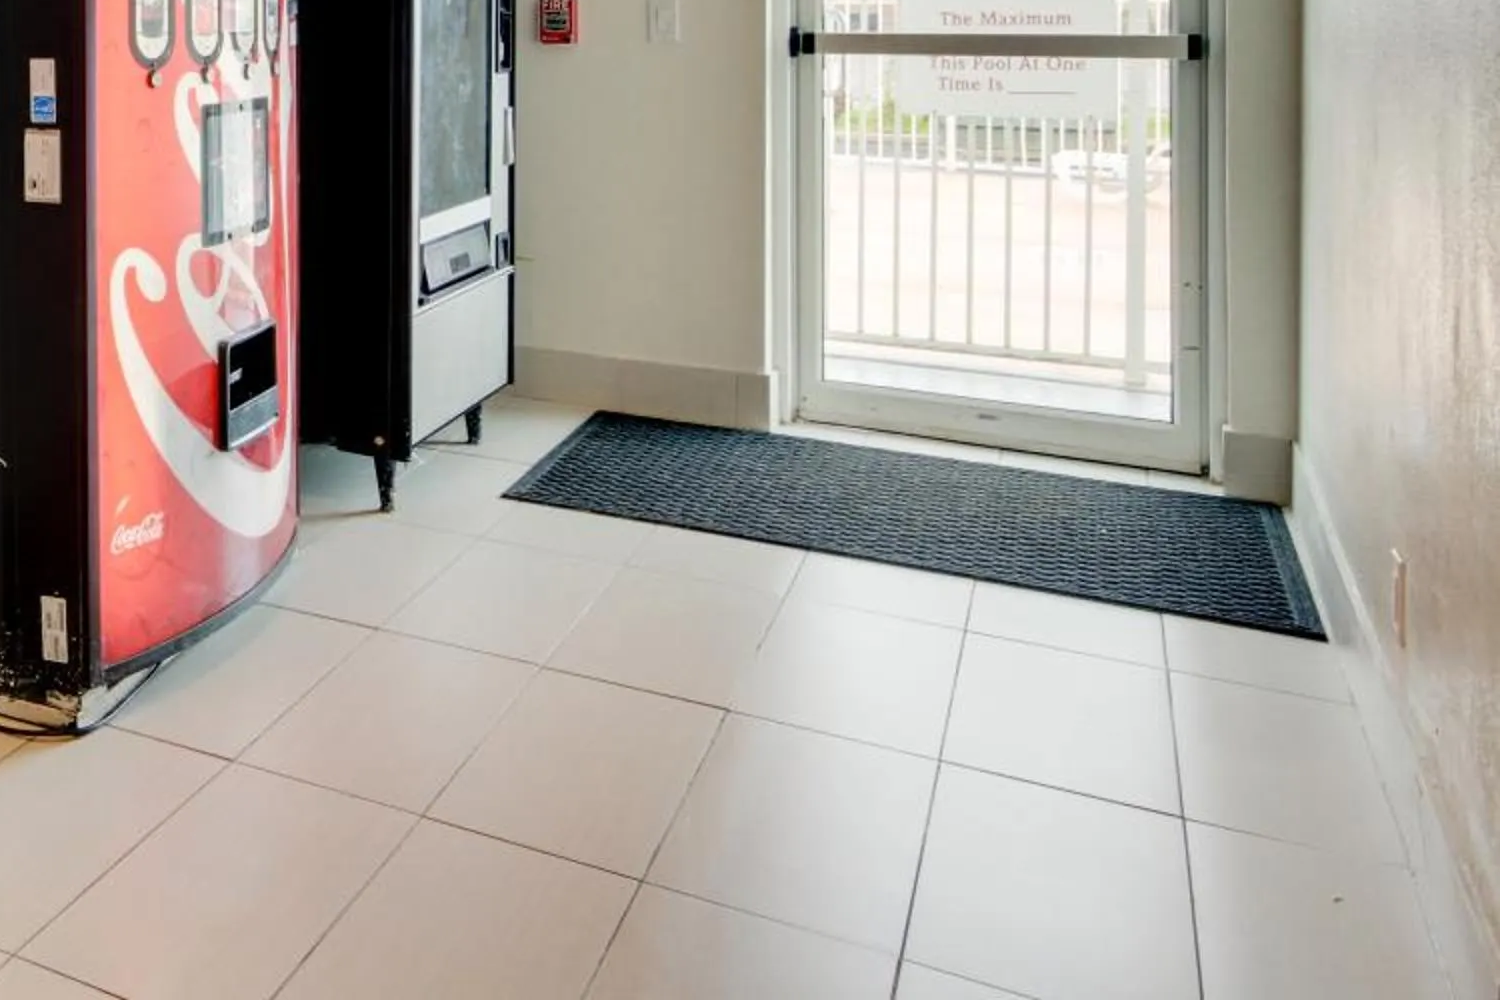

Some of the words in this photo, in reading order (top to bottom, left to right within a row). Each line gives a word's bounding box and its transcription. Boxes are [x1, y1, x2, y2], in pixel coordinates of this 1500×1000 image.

[940, 11, 973, 27] The
[980, 10, 1073, 27] Maximum
[931, 56, 967, 71] This
[973, 56, 1012, 71] Pool
[1019, 56, 1040, 71] At
[1046, 57, 1086, 72] One
[938, 76, 981, 92] Time
[987, 76, 1004, 92] Is
